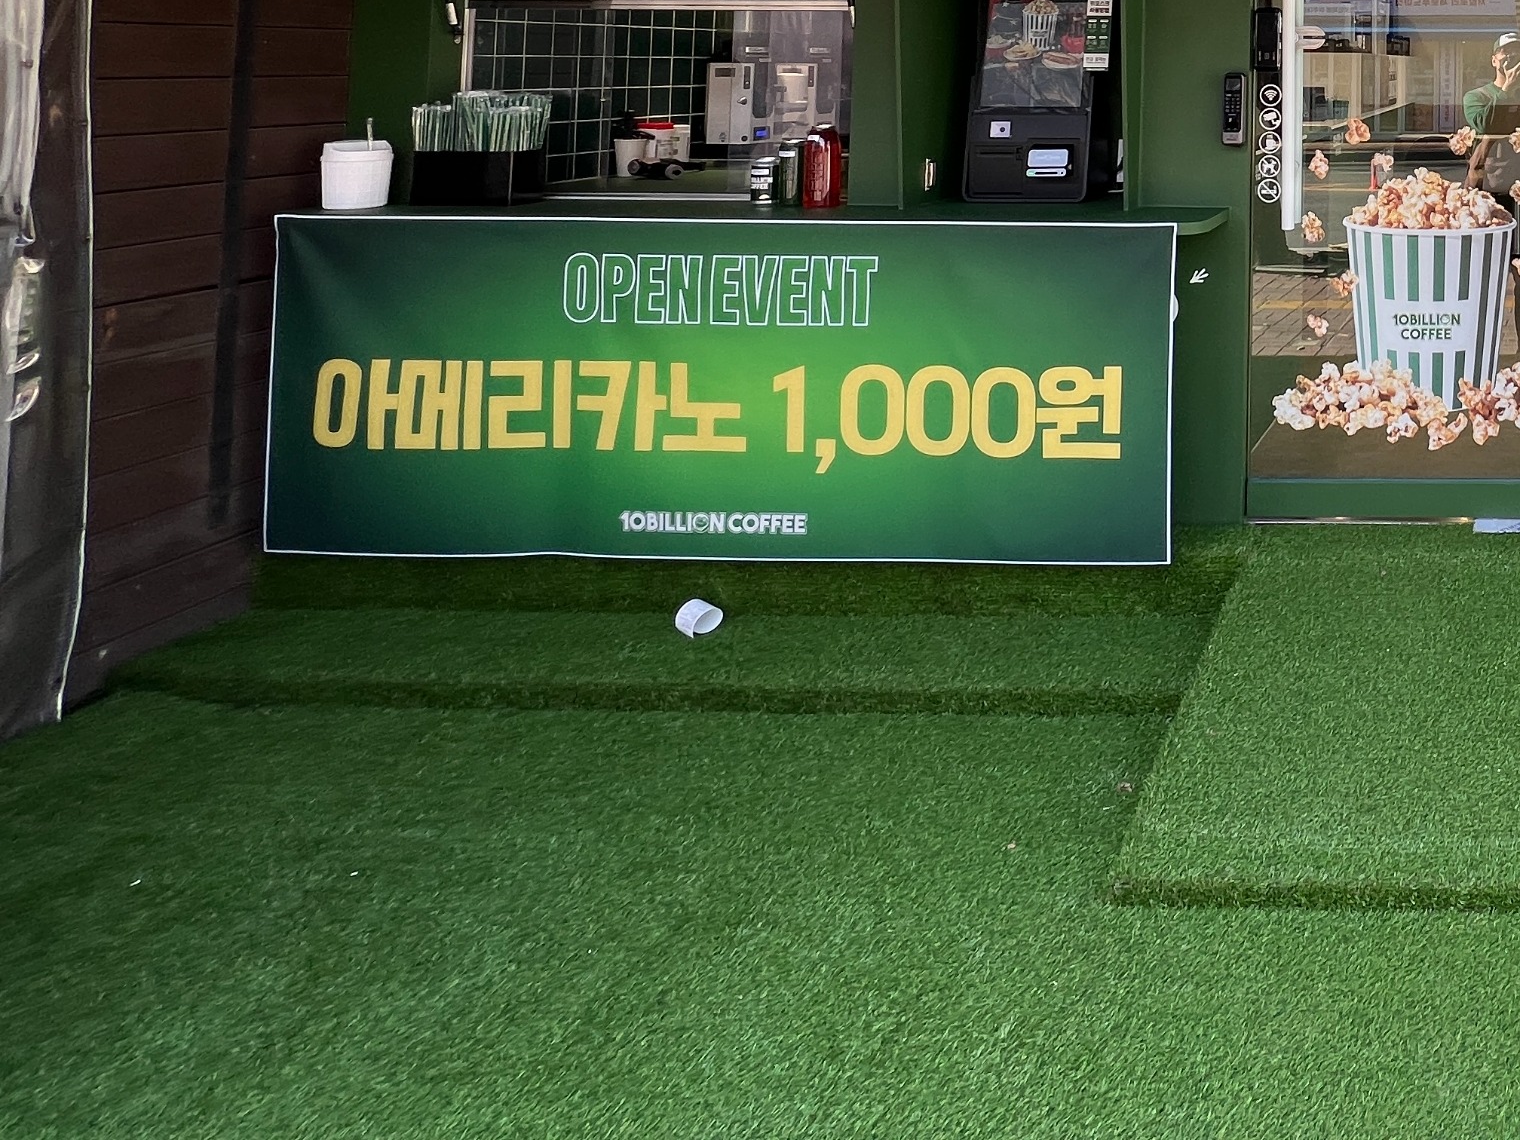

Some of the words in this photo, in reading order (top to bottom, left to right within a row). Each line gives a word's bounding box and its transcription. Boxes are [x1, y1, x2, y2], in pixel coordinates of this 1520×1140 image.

[562, 252, 704, 326] OPEN
[709, 254, 880, 327] EVENT
[1393, 313, 1461, 326] 10BILLION
[1401, 328, 1452, 340] COFFEE
[311, 357, 748, 453] 아메리카노
[772, 363, 1123, 475] 1,000원
[619, 510, 727, 534] 10BILLION
[727, 512, 809, 535] COFFEE
